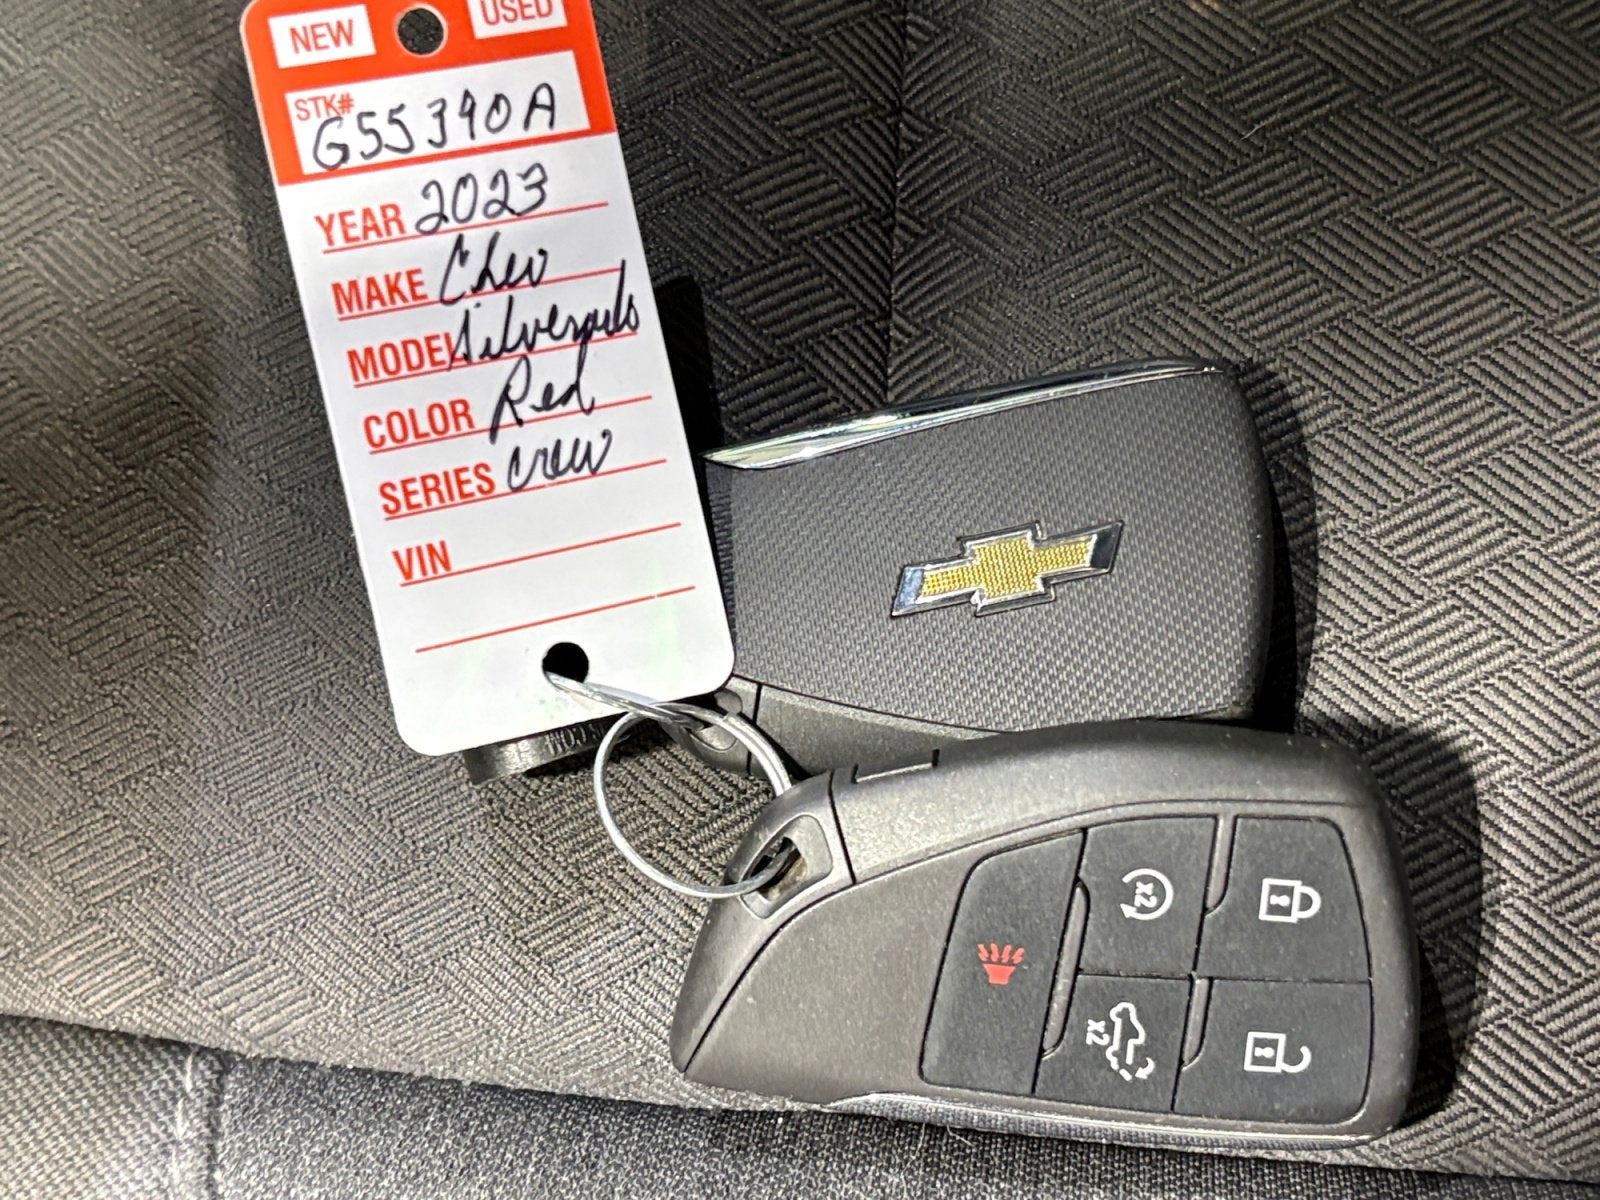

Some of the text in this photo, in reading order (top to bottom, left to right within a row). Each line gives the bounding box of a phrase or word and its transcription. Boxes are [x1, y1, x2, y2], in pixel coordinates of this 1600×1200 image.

[289, 19, 355, 54] NEW
[480, 0, 553, 26] USED
[294, 94, 355, 121] STK#
[415, 163, 548, 235] 2023
[314, 203, 406, 247] YEAR
[331, 268, 428, 315] MAKE
[346, 332, 464, 382] MODEL
[489, 340, 595, 445] Red
[363, 398, 475, 450] COLOR
[379, 463, 496, 515] SERIES
[391, 541, 452, 582] VIN
